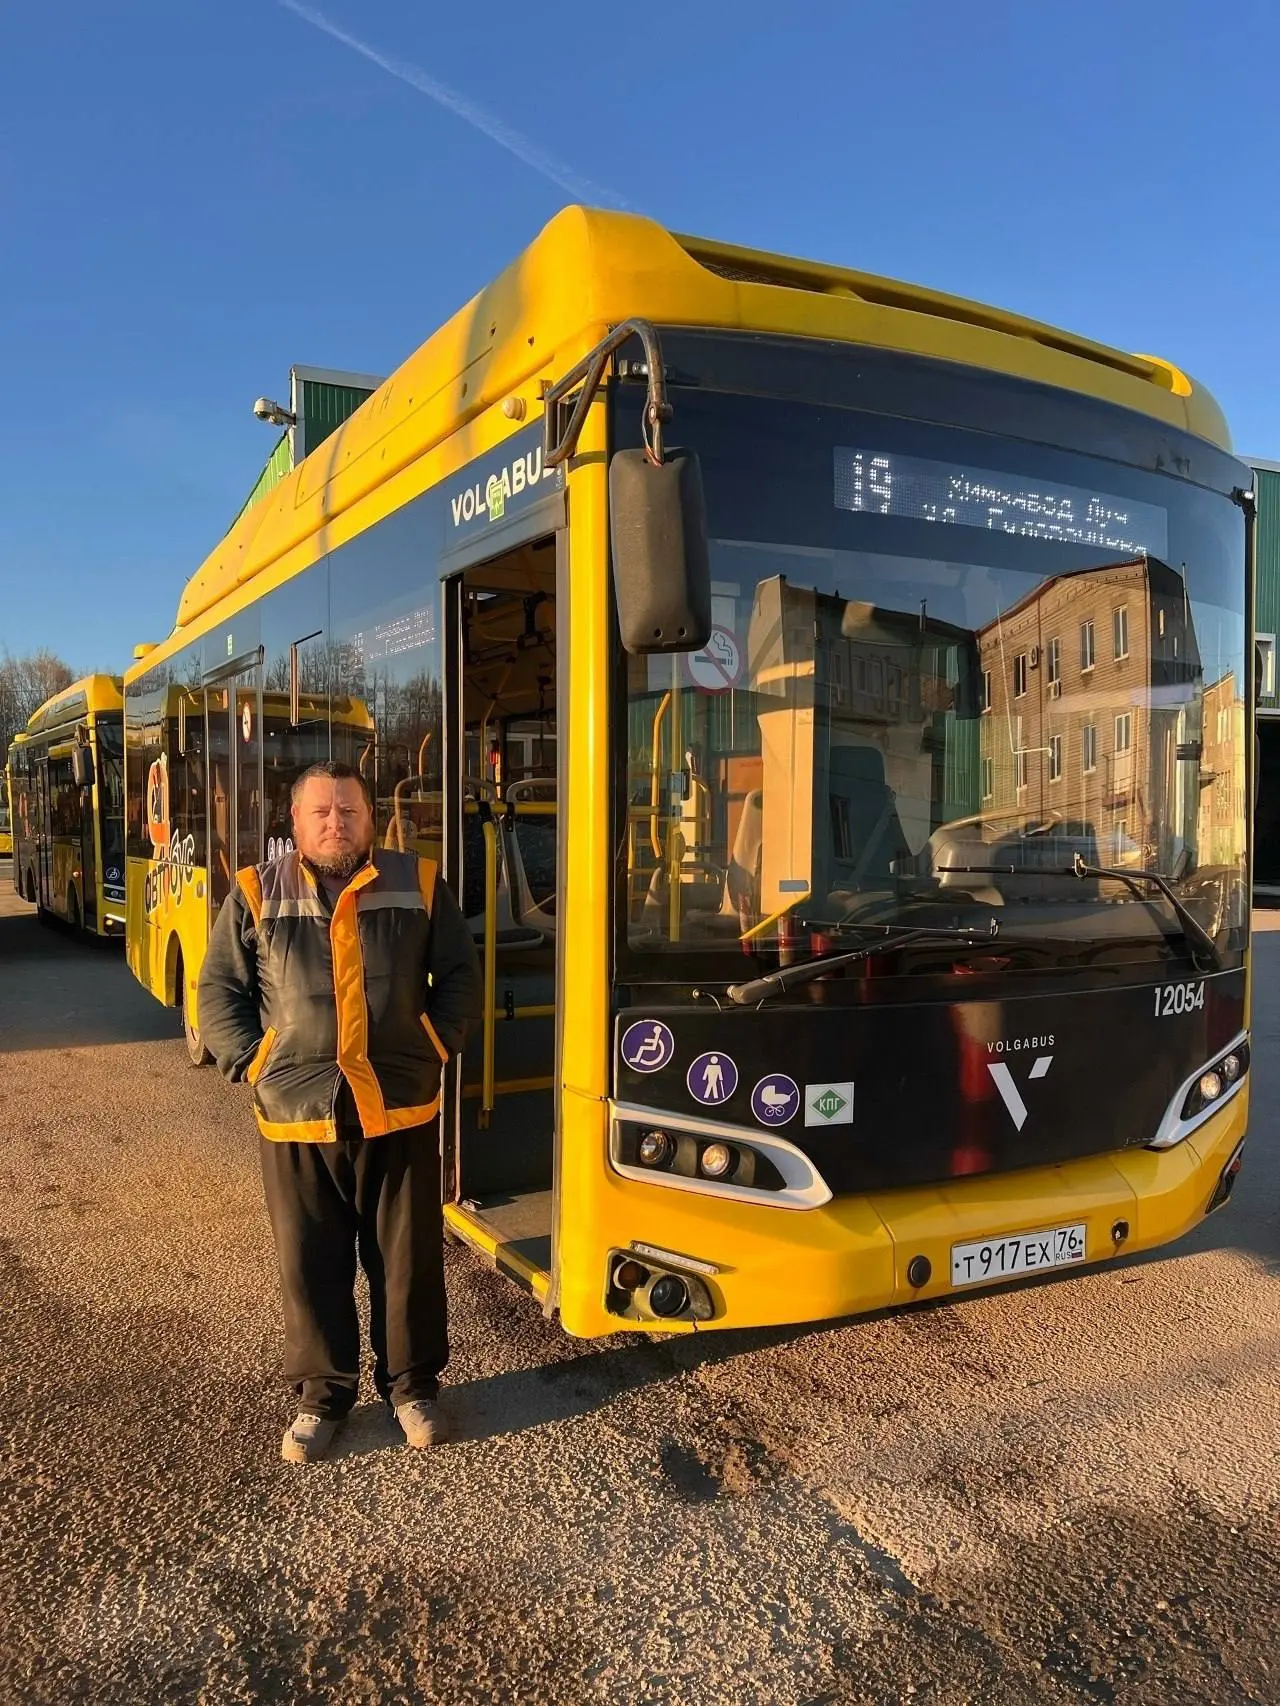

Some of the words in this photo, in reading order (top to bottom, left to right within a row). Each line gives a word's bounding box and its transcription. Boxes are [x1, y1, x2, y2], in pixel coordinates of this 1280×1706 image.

[853, 454, 891, 514] 19
[1154, 981, 1205, 1017] 12054
[987, 1034, 1056, 1054] VOLGABUS
[819, 1097, 840, 1111] КПГ
[1057, 1229, 1077, 1252] 76
[1055, 1251, 1071, 1261] RUS
